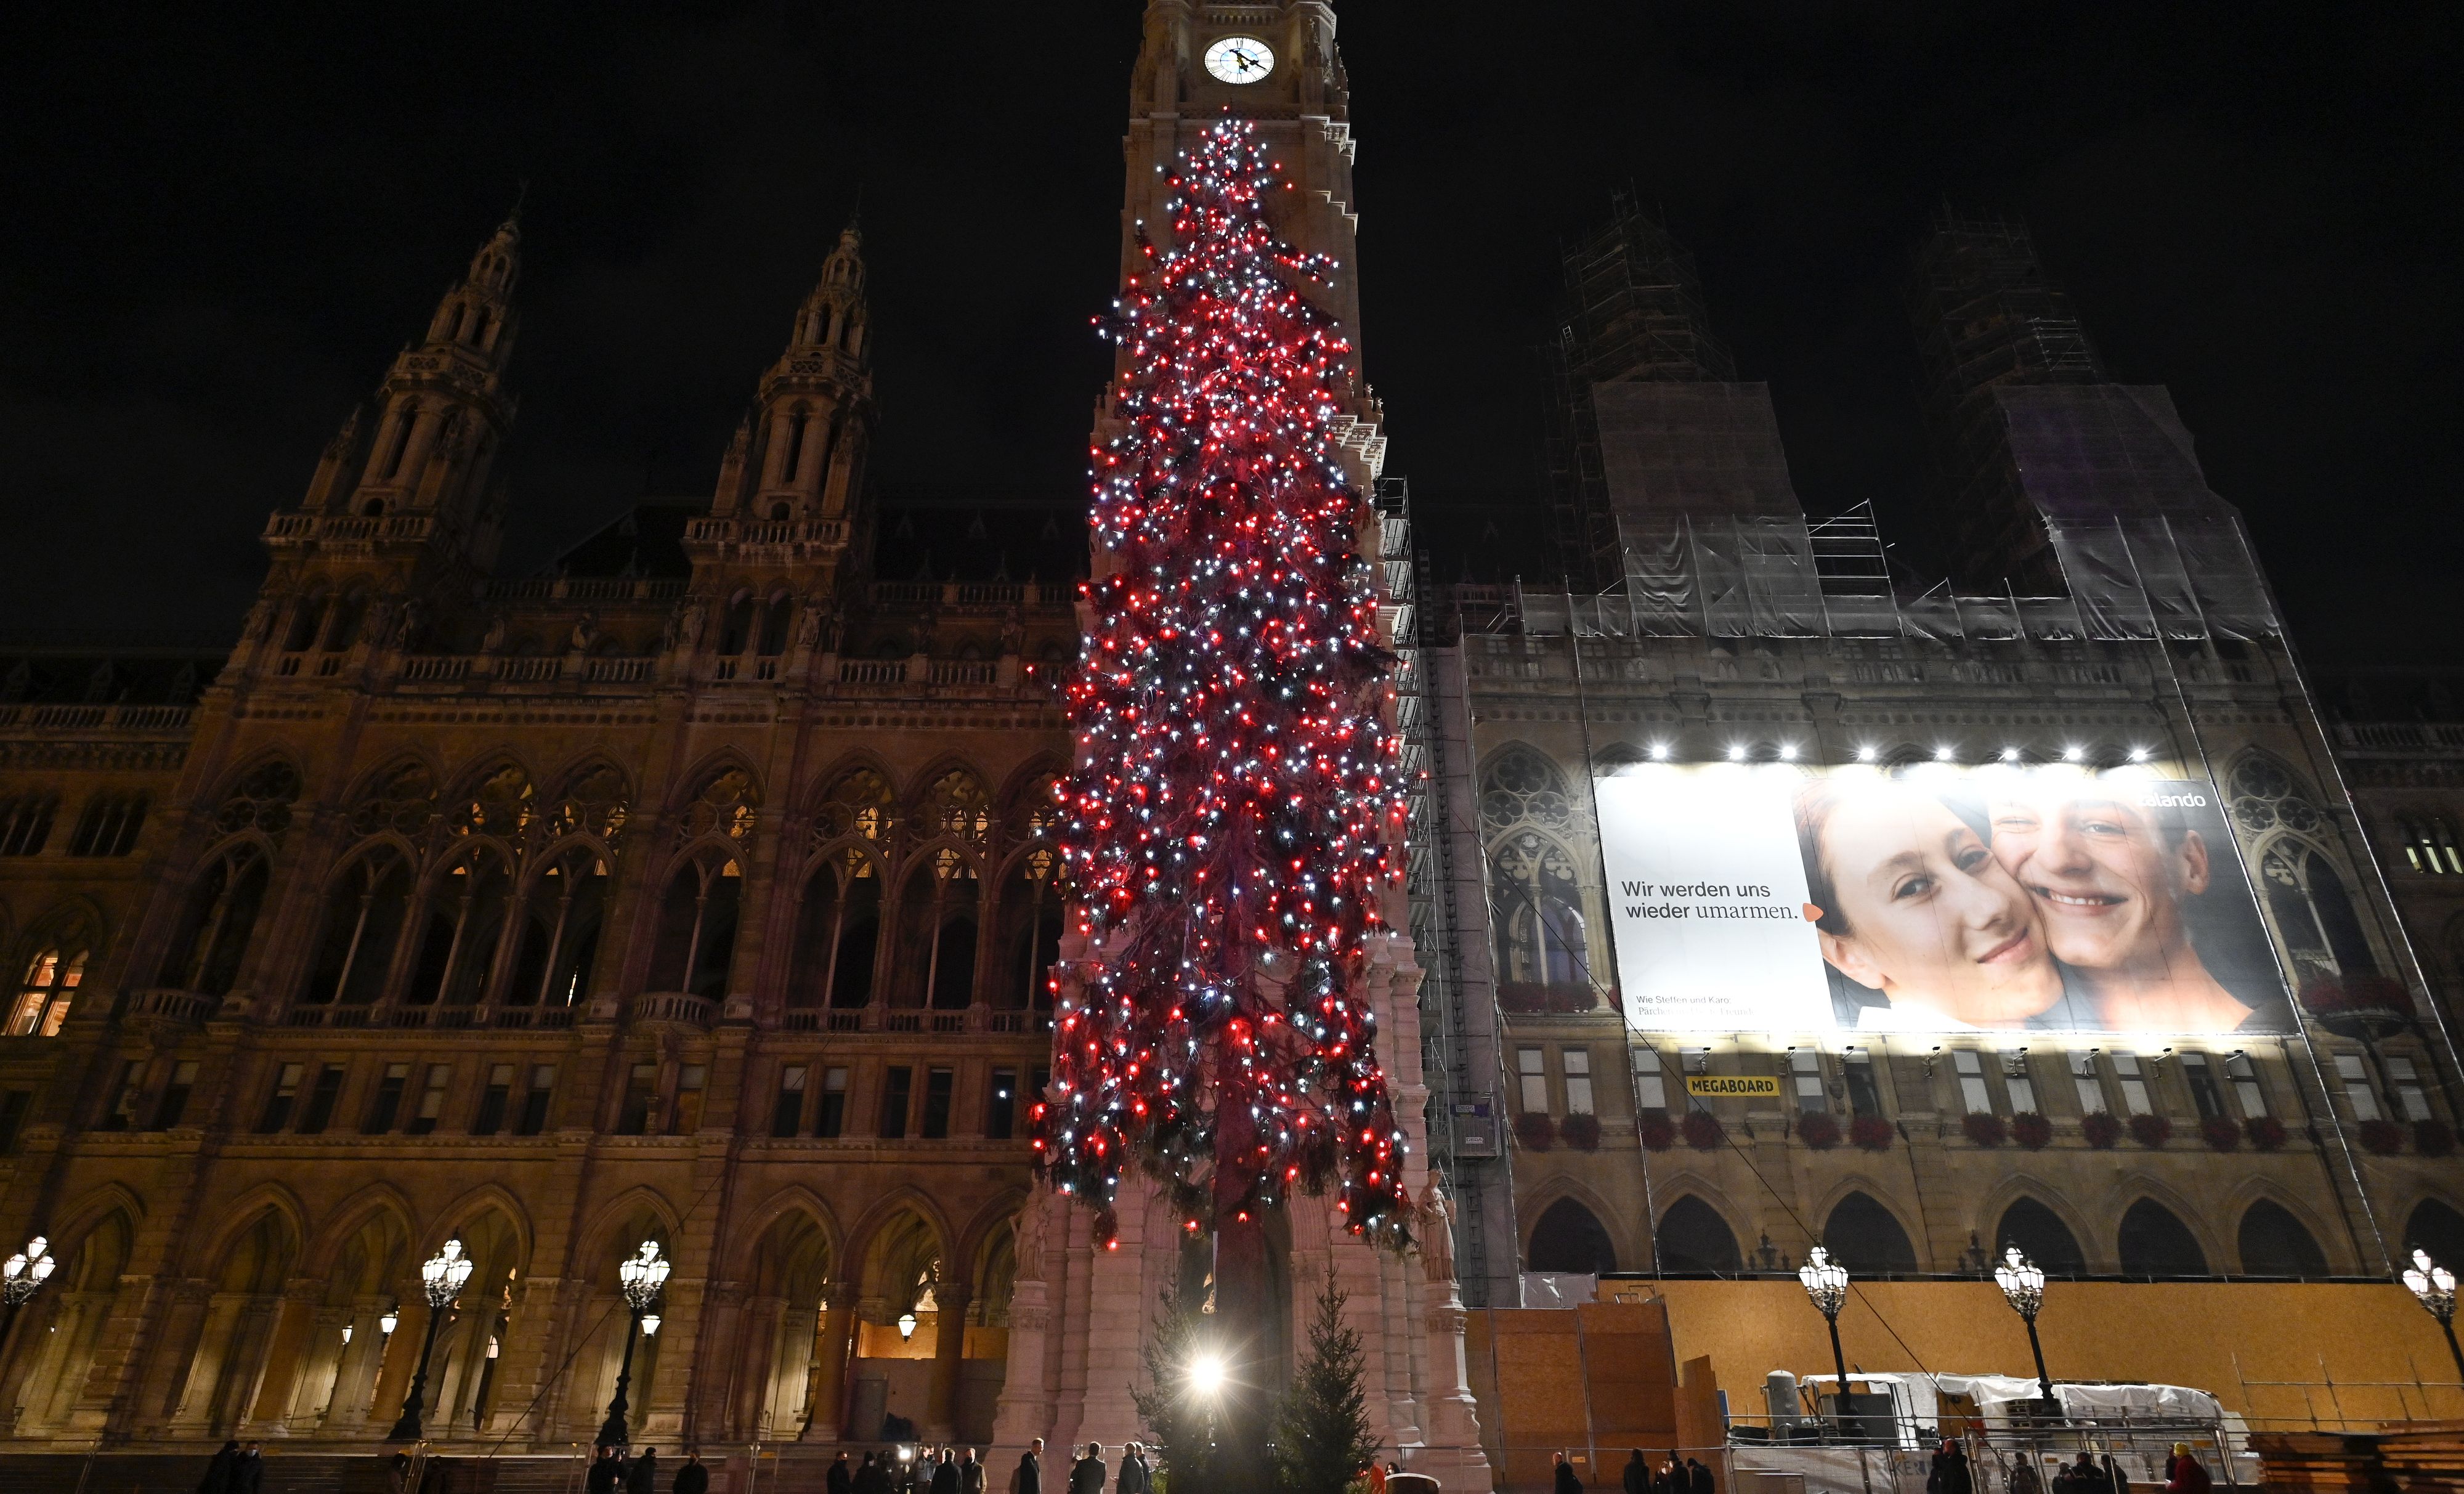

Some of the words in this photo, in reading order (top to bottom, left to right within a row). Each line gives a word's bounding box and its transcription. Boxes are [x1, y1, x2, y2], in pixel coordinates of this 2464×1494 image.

[1621, 881, 1654, 897] Wir
[1660, 881, 1730, 897] werden
[1736, 885, 1770, 898] uns
[1626, 903, 1690, 918] wieder
[1695, 903, 1799, 919] umarmen.
[1636, 996, 1653, 1004] Wie
[1656, 996, 1687, 1004] Steffen
[1692, 1079, 1774, 1093] MEGABOARD
